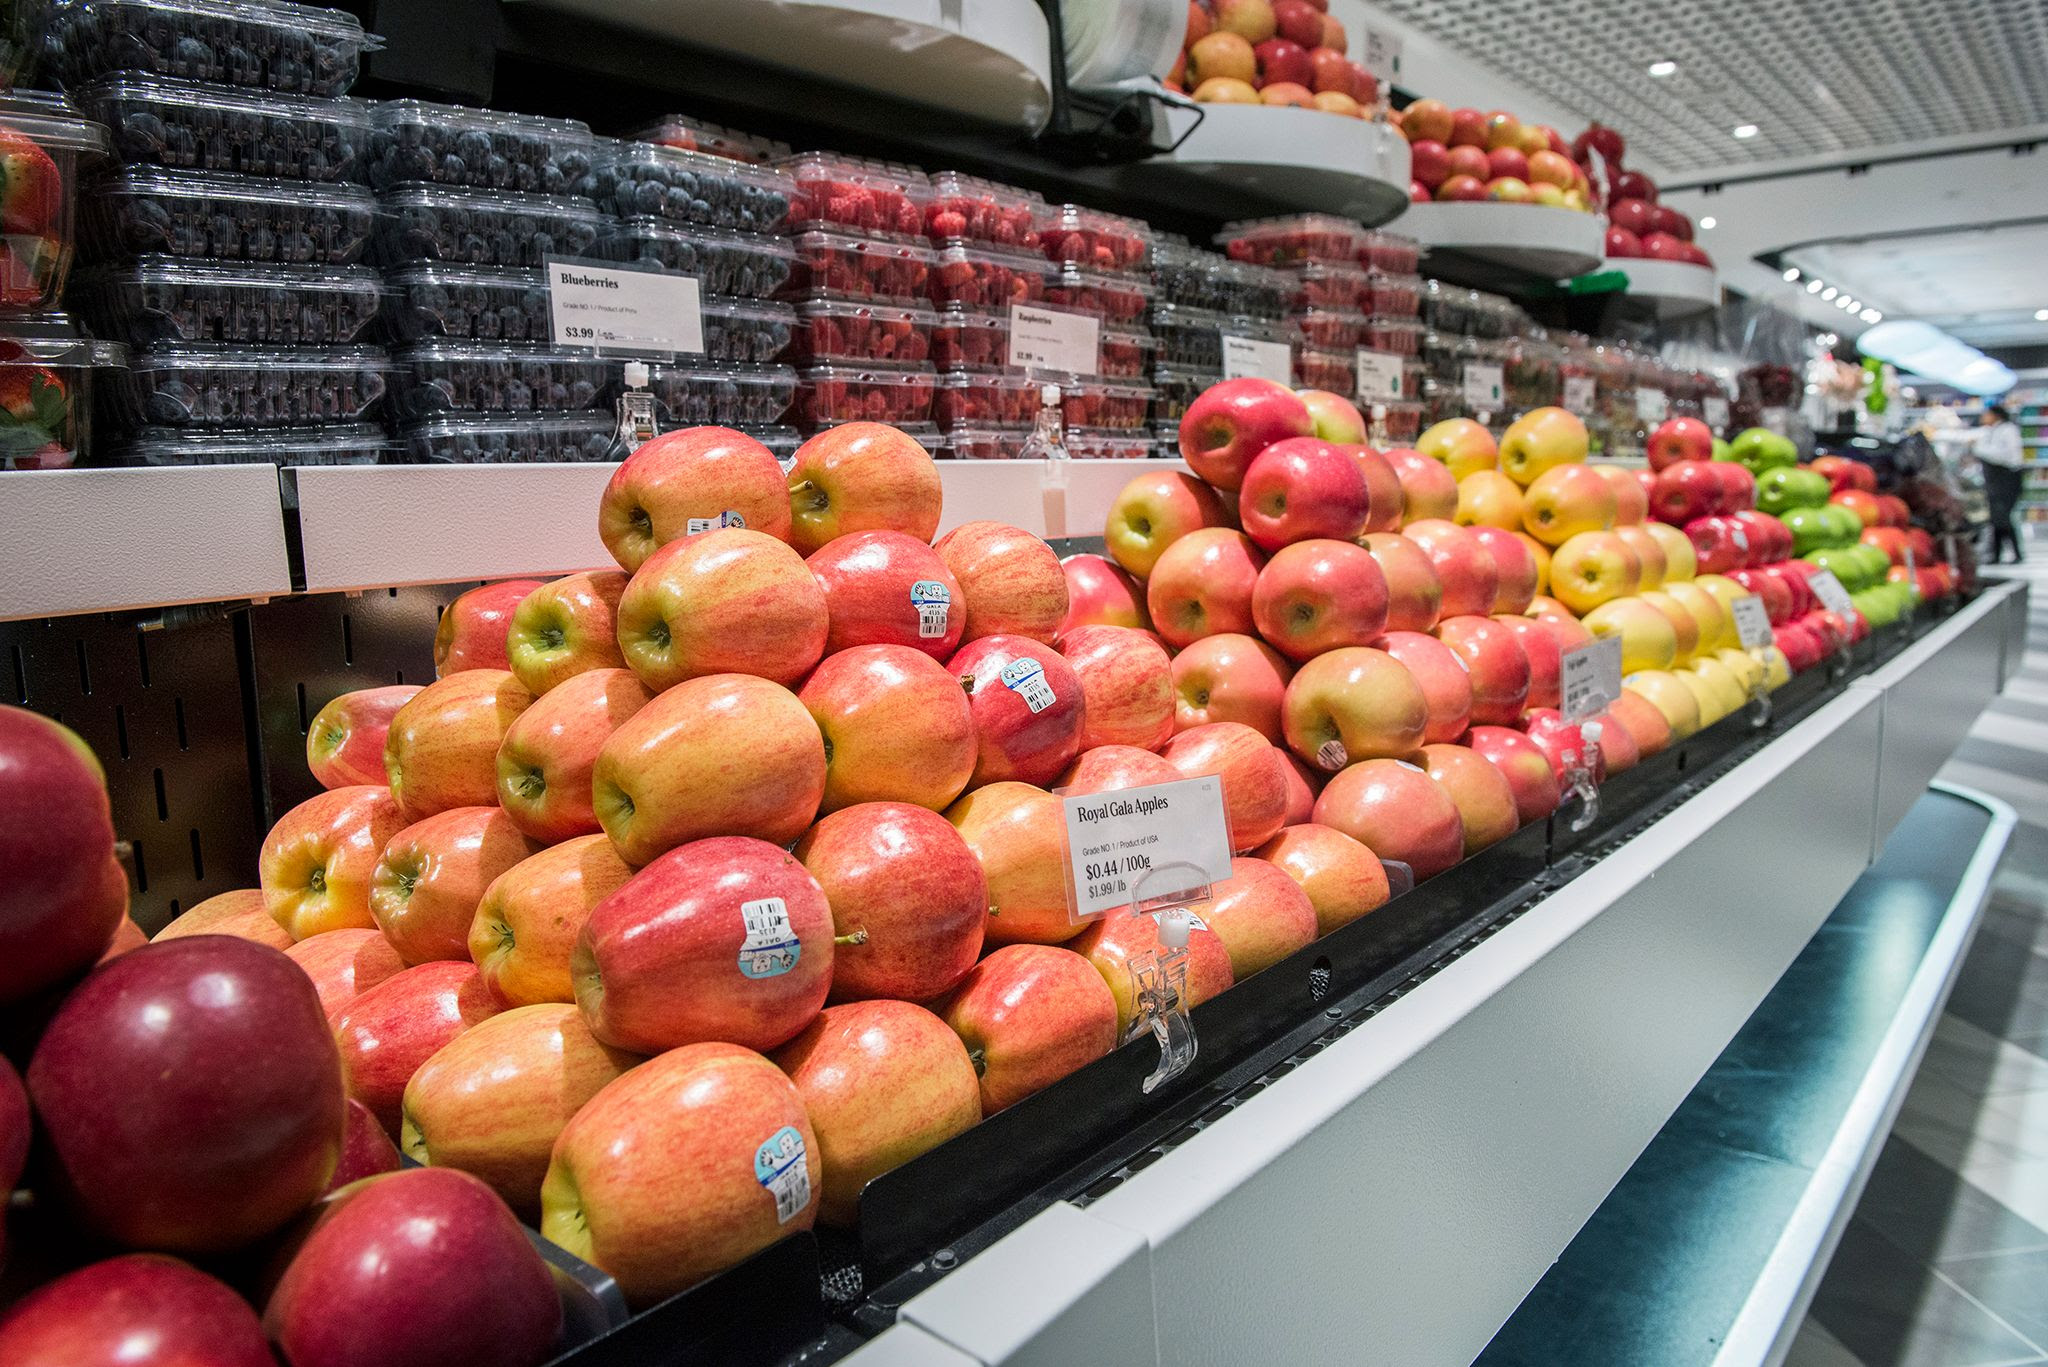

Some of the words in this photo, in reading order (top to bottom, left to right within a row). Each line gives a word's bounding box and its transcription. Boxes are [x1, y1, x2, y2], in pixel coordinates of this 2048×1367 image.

[561, 273, 619, 289] Blueberries
[598, 304, 618, 312] Product
[566, 326, 594, 338] $3.99
[1077, 804, 1108, 824] Royal
[1110, 800, 1134, 817] Gala
[1134, 796, 1168, 816] Apples
[1082, 846, 1100, 856] Grade
[1120, 838, 1140, 849] Product
[1140, 837, 1146, 845] of
[1147, 835, 1159, 844] USA
[1086, 860, 1118, 881] $0.44
[1120, 858, 1124, 873] /
[1126, 854, 1151, 874] 100g
[1118, 880, 1126, 892] lb
[758, 937, 781, 946] GALA
